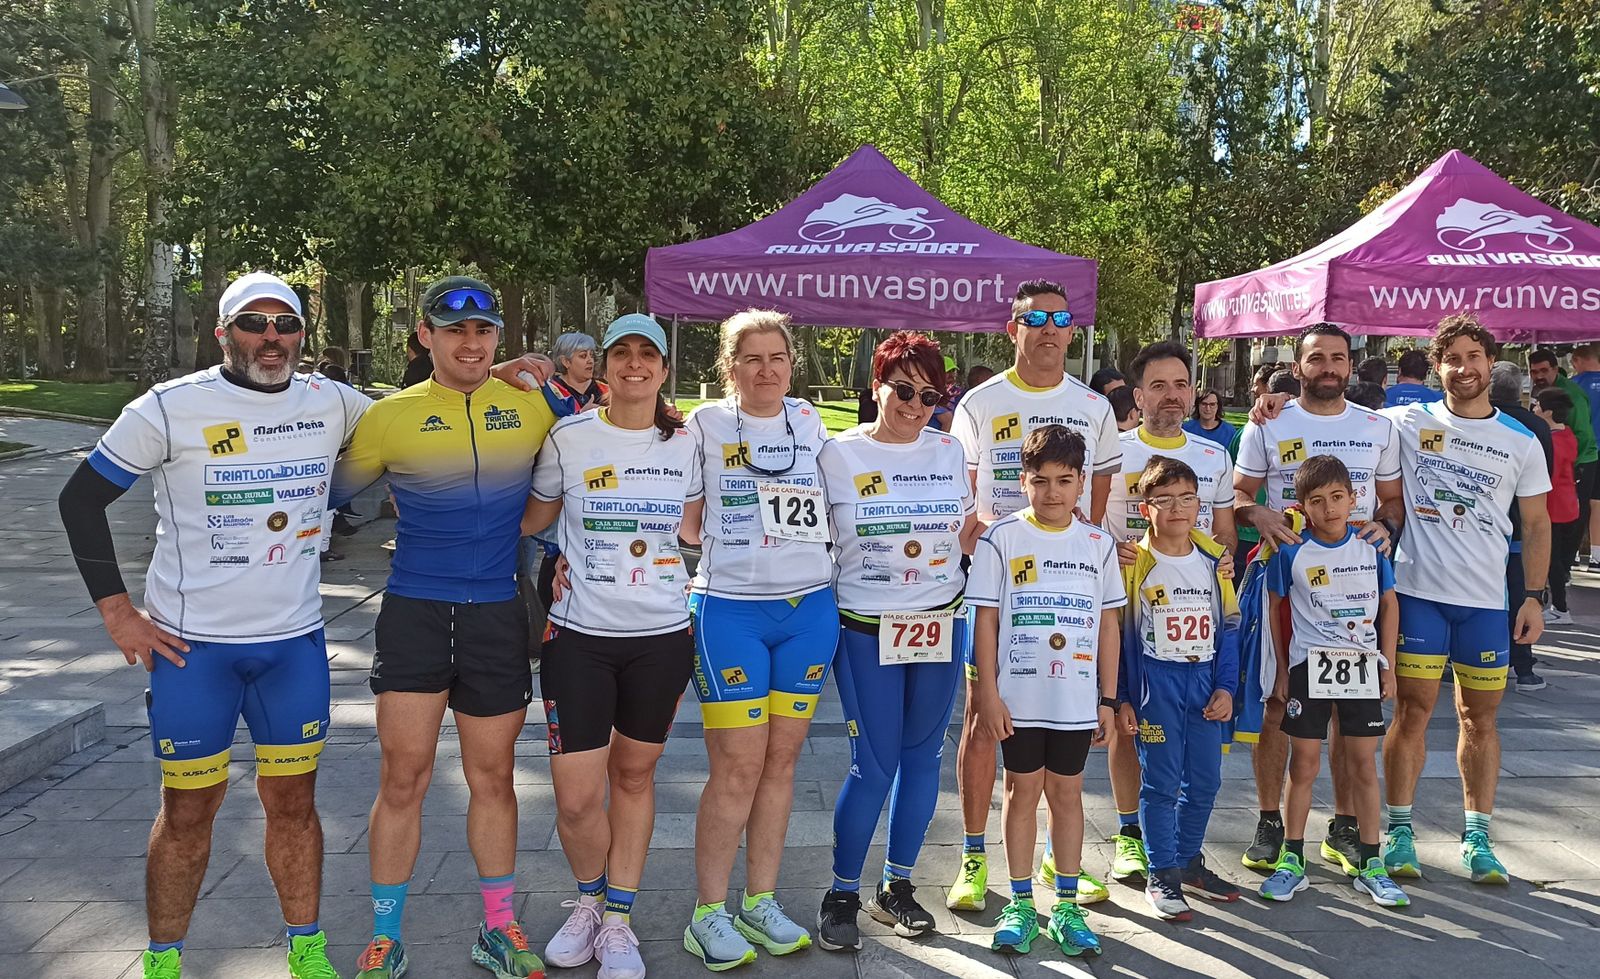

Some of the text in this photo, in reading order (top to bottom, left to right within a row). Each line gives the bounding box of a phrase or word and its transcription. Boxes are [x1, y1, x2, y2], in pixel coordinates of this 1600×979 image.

[765, 242, 979, 254] RUN VA SPORT
[1427, 253, 1489, 265] RUN
[1487, 252, 1532, 264] VA
[687, 270, 1013, 310] www.runvasport.
[297, 419, 325, 434] Peña
[485, 420, 522, 431] DUERO
[1067, 417, 1089, 428] Peña
[995, 451, 1020, 461] TRIAT
[1486, 446, 1509, 459] Peña
[213, 462, 326, 482] TRIATLON DUERO
[1350, 471, 1369, 480] ERO
[245, 490, 271, 499] RURAL
[276, 486, 316, 499] VALDÉS
[589, 501, 682, 514] TRIATLON DUERO
[768, 496, 818, 528] 123
[862, 503, 959, 516] TRIATLON DUERO
[914, 522, 949, 531] VALDÉS
[1017, 596, 1092, 609] TRIATLON DUERO
[1346, 592, 1370, 600] VALDÉS
[1057, 615, 1085, 626] VALDÉS
[892, 621, 941, 647] 729
[1166, 615, 1210, 641] 526
[694, 657, 710, 697] DUERO
[1317, 659, 1366, 684] 281
[1140, 735, 1166, 743] DUERO
